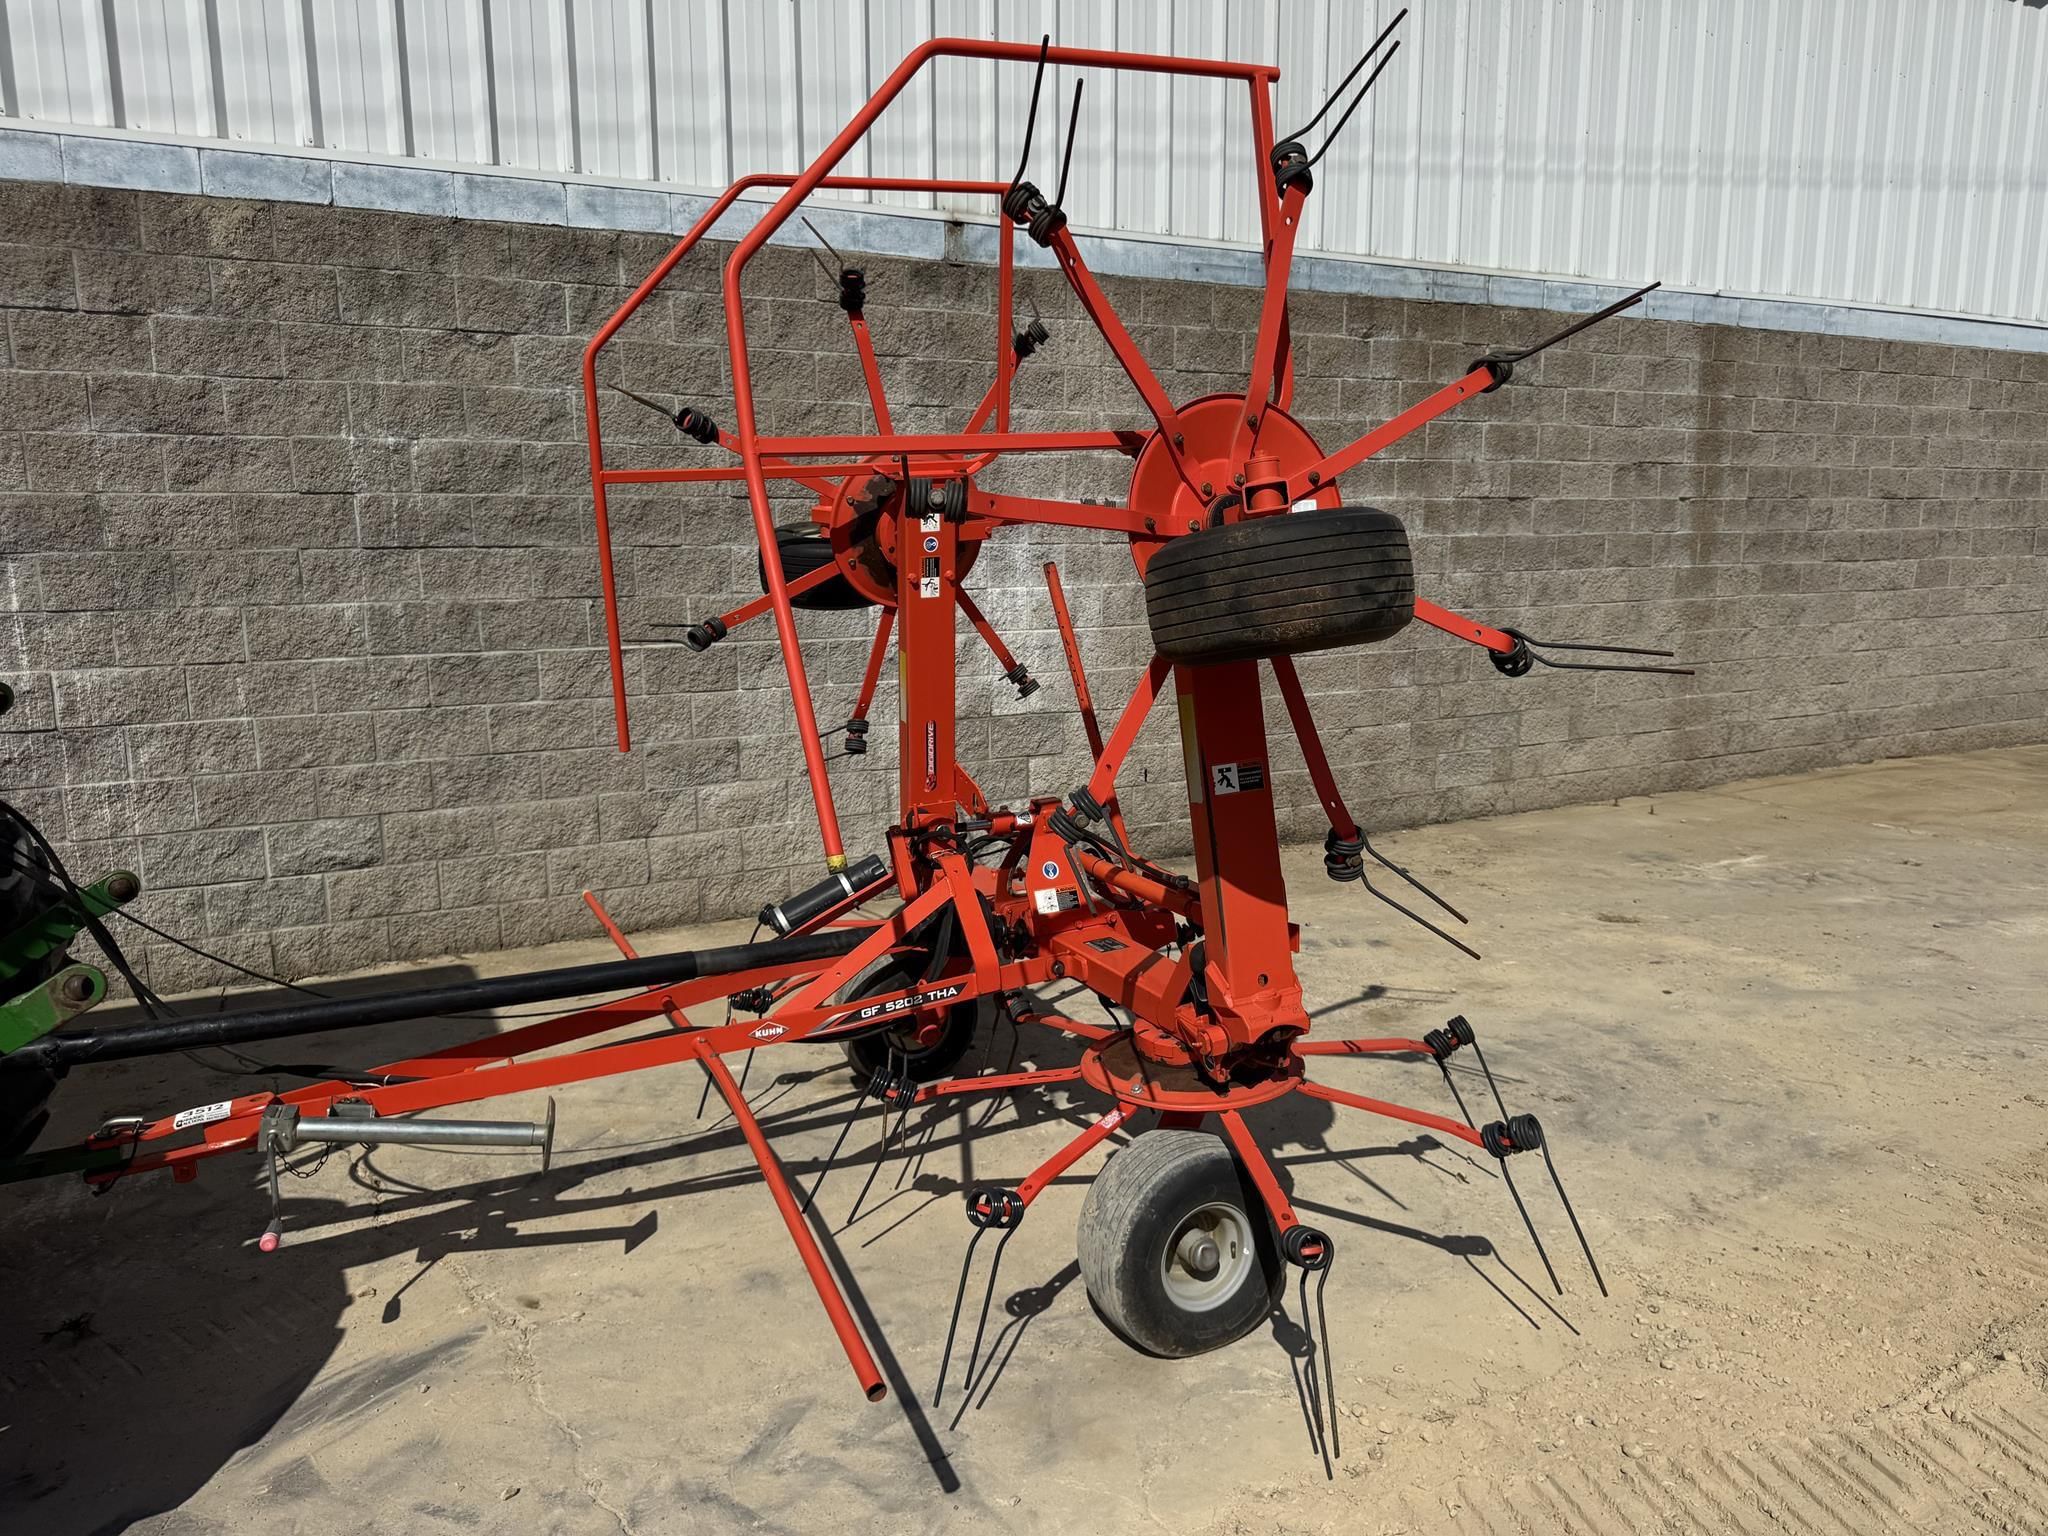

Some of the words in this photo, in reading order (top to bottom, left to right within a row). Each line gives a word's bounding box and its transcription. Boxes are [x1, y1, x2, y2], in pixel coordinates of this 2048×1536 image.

[861, 1006, 880, 1018] GF
[885, 996, 923, 1011] 5202
[927, 987, 957, 1000] THA
[755, 1027, 783, 1038] KUHN
[182, 1104, 223, 1118] 3512
